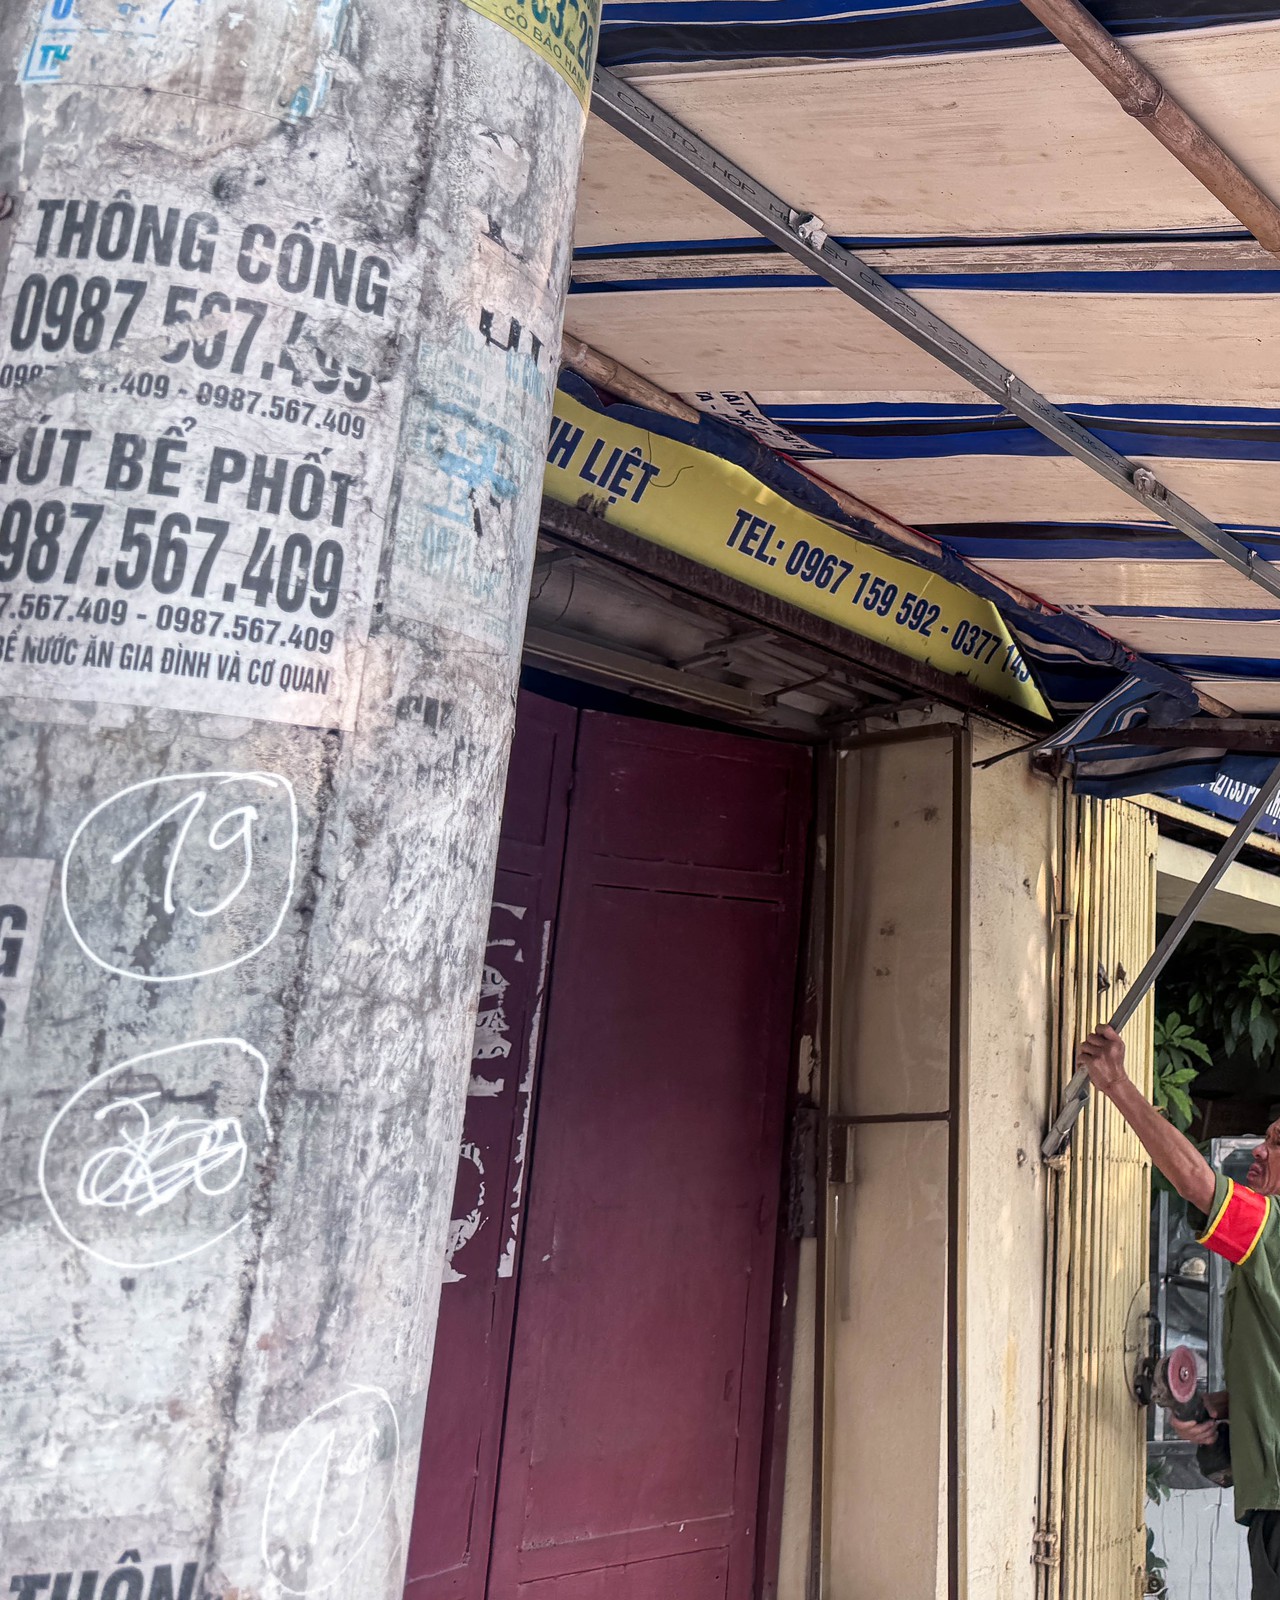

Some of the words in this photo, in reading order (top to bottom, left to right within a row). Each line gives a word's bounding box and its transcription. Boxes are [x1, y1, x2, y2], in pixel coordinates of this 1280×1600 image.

[34, 189, 219, 275] THÔNG
[237, 216, 391, 318] CỐNG
[196, 381, 367, 440] 0987.567.409
[104, 416, 197, 498] BỂ
[204, 447, 358, 529] PHỐT
[578, 438, 661, 505] LIỆT
[156, 604, 335, 655] 0987.567.409
[726, 508, 787, 567] TEL:
[785, 540, 854, 595] 0967
[852, 571, 899, 617] 159
[895, 592, 942, 638] 592
[951, 620, 1004, 665] 0377
[21, 632, 79, 667] NƯỚC
[82, 634, 115, 668] ĂN
[119, 642, 154, 673] GIA
[160, 642, 212, 679] ĐÌNH
[217, 650, 241, 683] VÀ
[247, 658, 277, 687] CƠ
[279, 662, 330, 696] QUAN
[111, 790, 258, 917] 19
